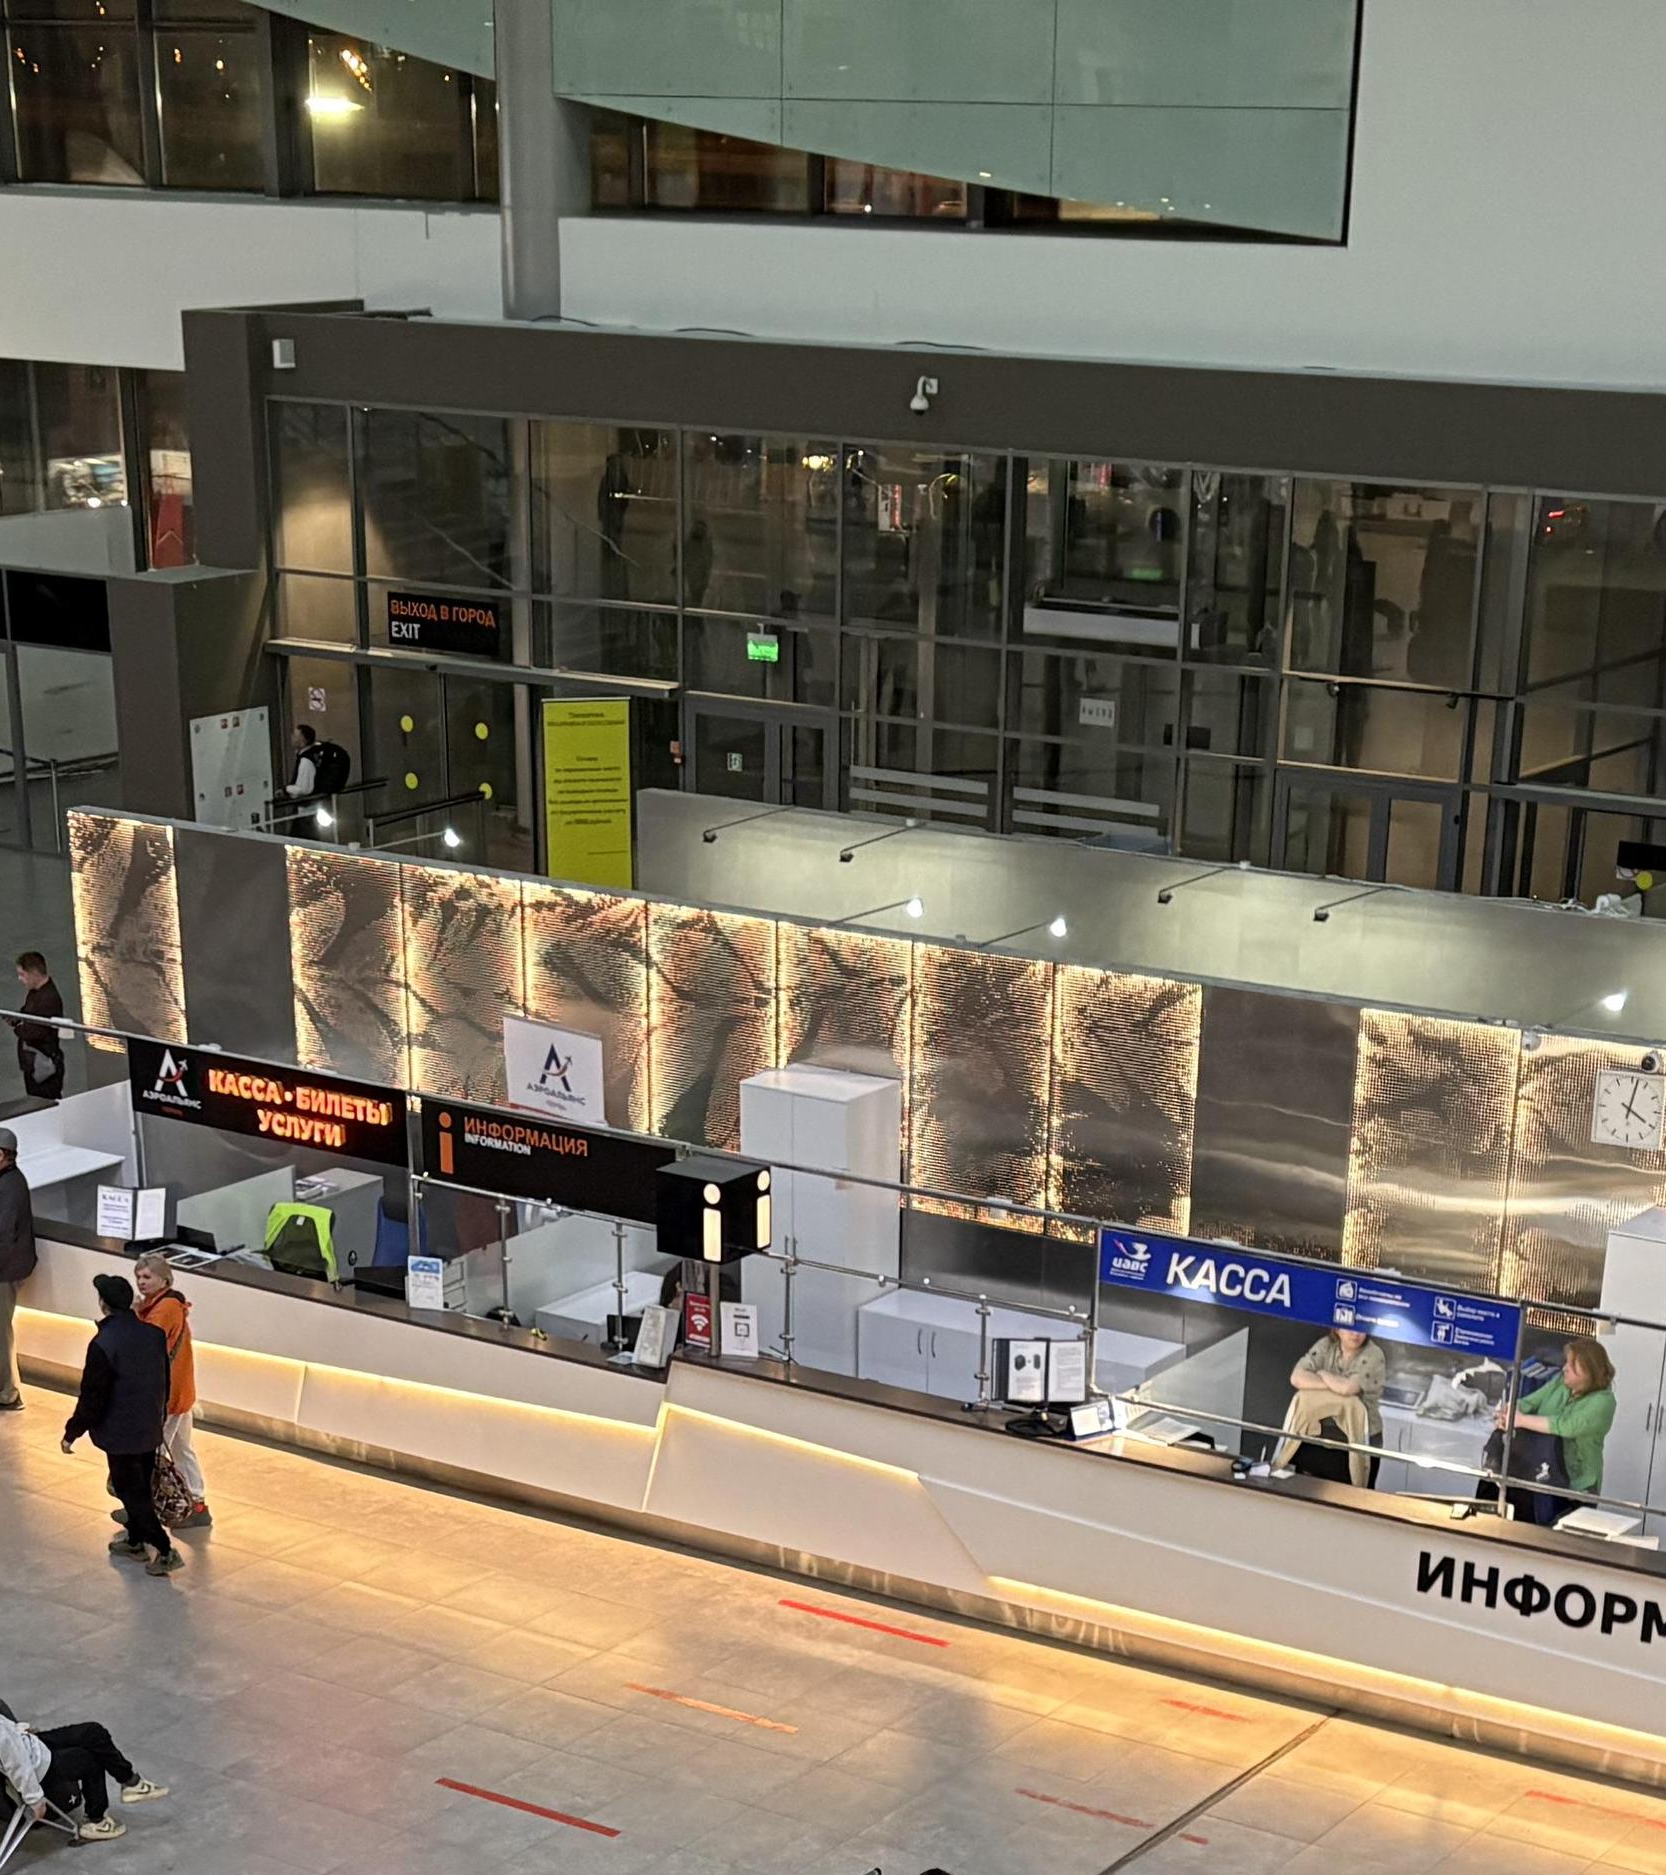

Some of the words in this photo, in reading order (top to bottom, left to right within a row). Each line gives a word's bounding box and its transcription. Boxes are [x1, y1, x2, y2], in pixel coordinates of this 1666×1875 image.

[390, 599, 438, 622] ВЫХОД
[439, 604, 450, 621] В
[452, 605, 497, 629] ГОРОД
[390, 620, 421, 640] EXIT
[207, 1068, 284, 1105] КАССА
[295, 1085, 393, 1126] БИЛЕТЫ
[256, 1108, 346, 1148] УСЛУГИ
[463, 1115, 589, 1158] ИНФОРМАЦИЯ
[463, 1132, 532, 1156] INFORMATION
[1165, 1251, 1292, 1309] КАССА
